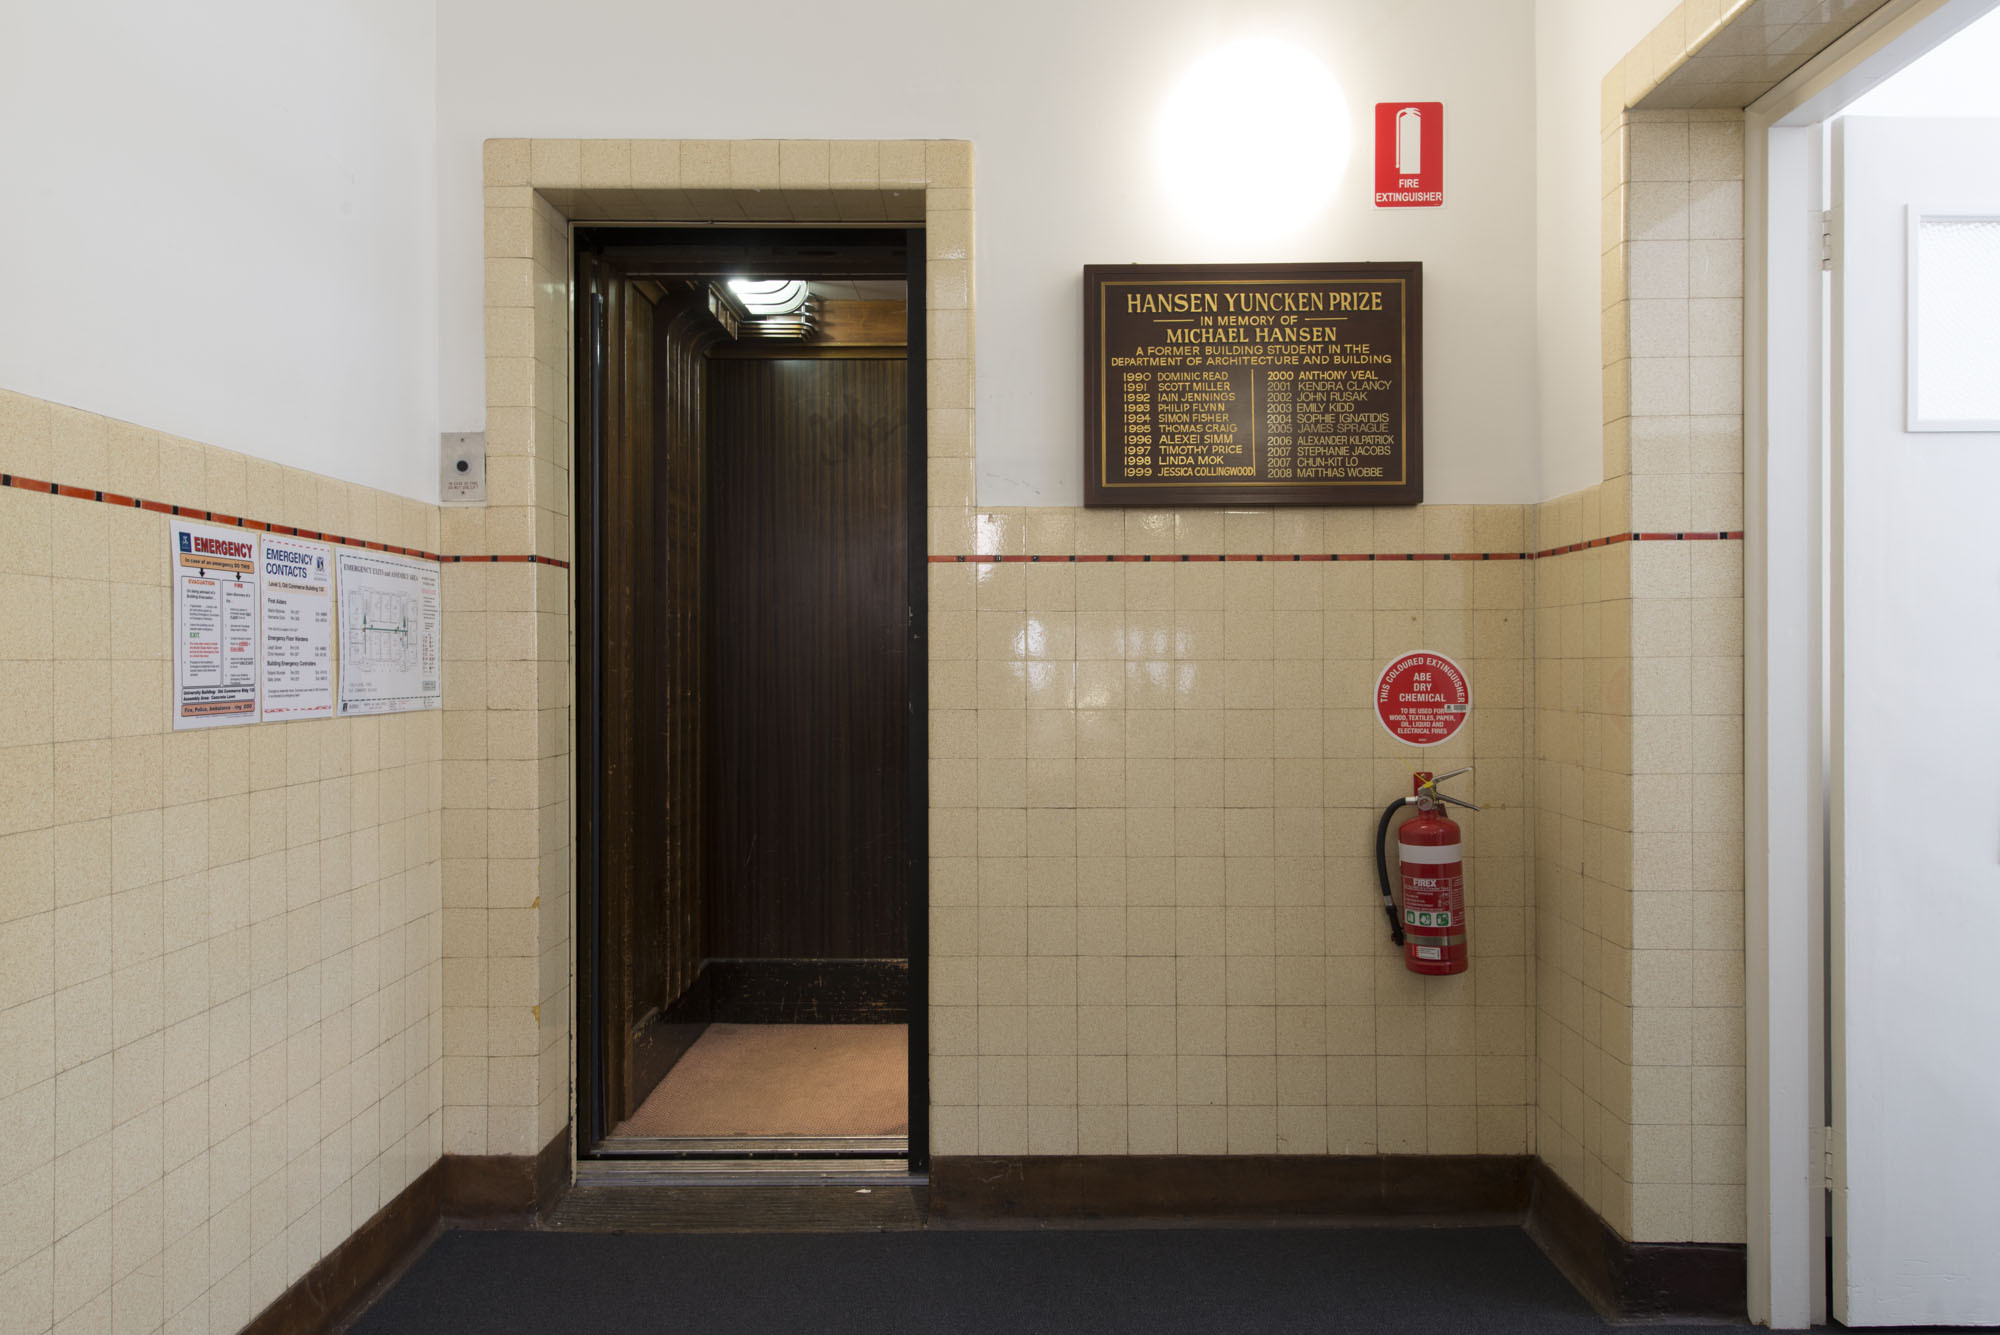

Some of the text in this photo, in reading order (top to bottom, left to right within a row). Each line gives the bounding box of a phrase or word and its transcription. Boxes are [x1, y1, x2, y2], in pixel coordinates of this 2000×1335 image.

[1399, 179, 1419, 188] FIRE
[1376, 192, 1442, 202] EXTINGUISHER
[1127, 291, 1383, 313] HANSEN YUNCKEN PRIZE
[1200, 315, 1298, 326] IN MEMORY OF
[1166, 327, 1337, 343] MICHAEL HANSEN
[1136, 344, 1370, 356] A FORMER BUILDING STUDENT IN THE
[1112, 354, 1392, 367] DEPARTMENT OF ARCHITECTURE AND BUILDING
[1124, 372, 1228, 382] 1990 DOMINIC READ
[1267, 370, 1378, 380] 2000 ANTHONY VEAL
[1124, 382, 1231, 392] 1991 SCOTT MILLER
[1267, 380, 1392, 392] 2001 KENDRA CLANCY
[1124, 392, 1236, 402] 1992 IAIN JENNINGS
[1267, 392, 1368, 402] 2002 JOHN RUSAK
[1124, 403, 1225, 412] 1993 PHILIP FLYNN
[1267, 403, 1355, 413] 2003 EMILY KIDD
[1124, 414, 1230, 423] 1994 SIMON FISHER
[1267, 413, 1390, 424] 2004 SOPHIE IGNATIDIS
[1124, 424, 1238, 434] 1995 THOMAS CRAIG
[1267, 424, 1388, 434] 2005 JAMES SPRAGUE
[1124, 434, 1233, 444] 1996 ALEXEI SIMM
[1267, 435, 1394, 446] 2006 ALEXANDER KILPATRICK
[1124, 445, 1243, 455] 1997 TIMOTHY PRICE
[1267, 446, 1391, 456] 2007 STEPHANIE JACOBS
[1124, 456, 1224, 465] 1998 LINDA MOK
[1267, 456, 1358, 468] 2007 CHUN-KIT LO
[1124, 466, 1254, 477] 1999 JESSICA COLLINGWOOD
[1268, 468, 1383, 478] 2008 MATTHIAS WOBBE
[194, 536, 252, 558] EMERGENCY
[266, 548, 313, 565] EMERGENCY
[266, 562, 308, 578] CONTACTS
[344, 564, 372, 574] EMERGENCY
[372, 568, 384, 576] EXITS
[392, 572, 408, 580] ASSEMBLY
[1380, 657, 1466, 703] THIS COLOURED EXTINGUISHER
[1413, 672, 1432, 682] ABE
[1413, 682, 1432, 692] DRY
[1399, 693, 1447, 702] CHEMICAL
[1413, 879, 1437, 888] FIREX
